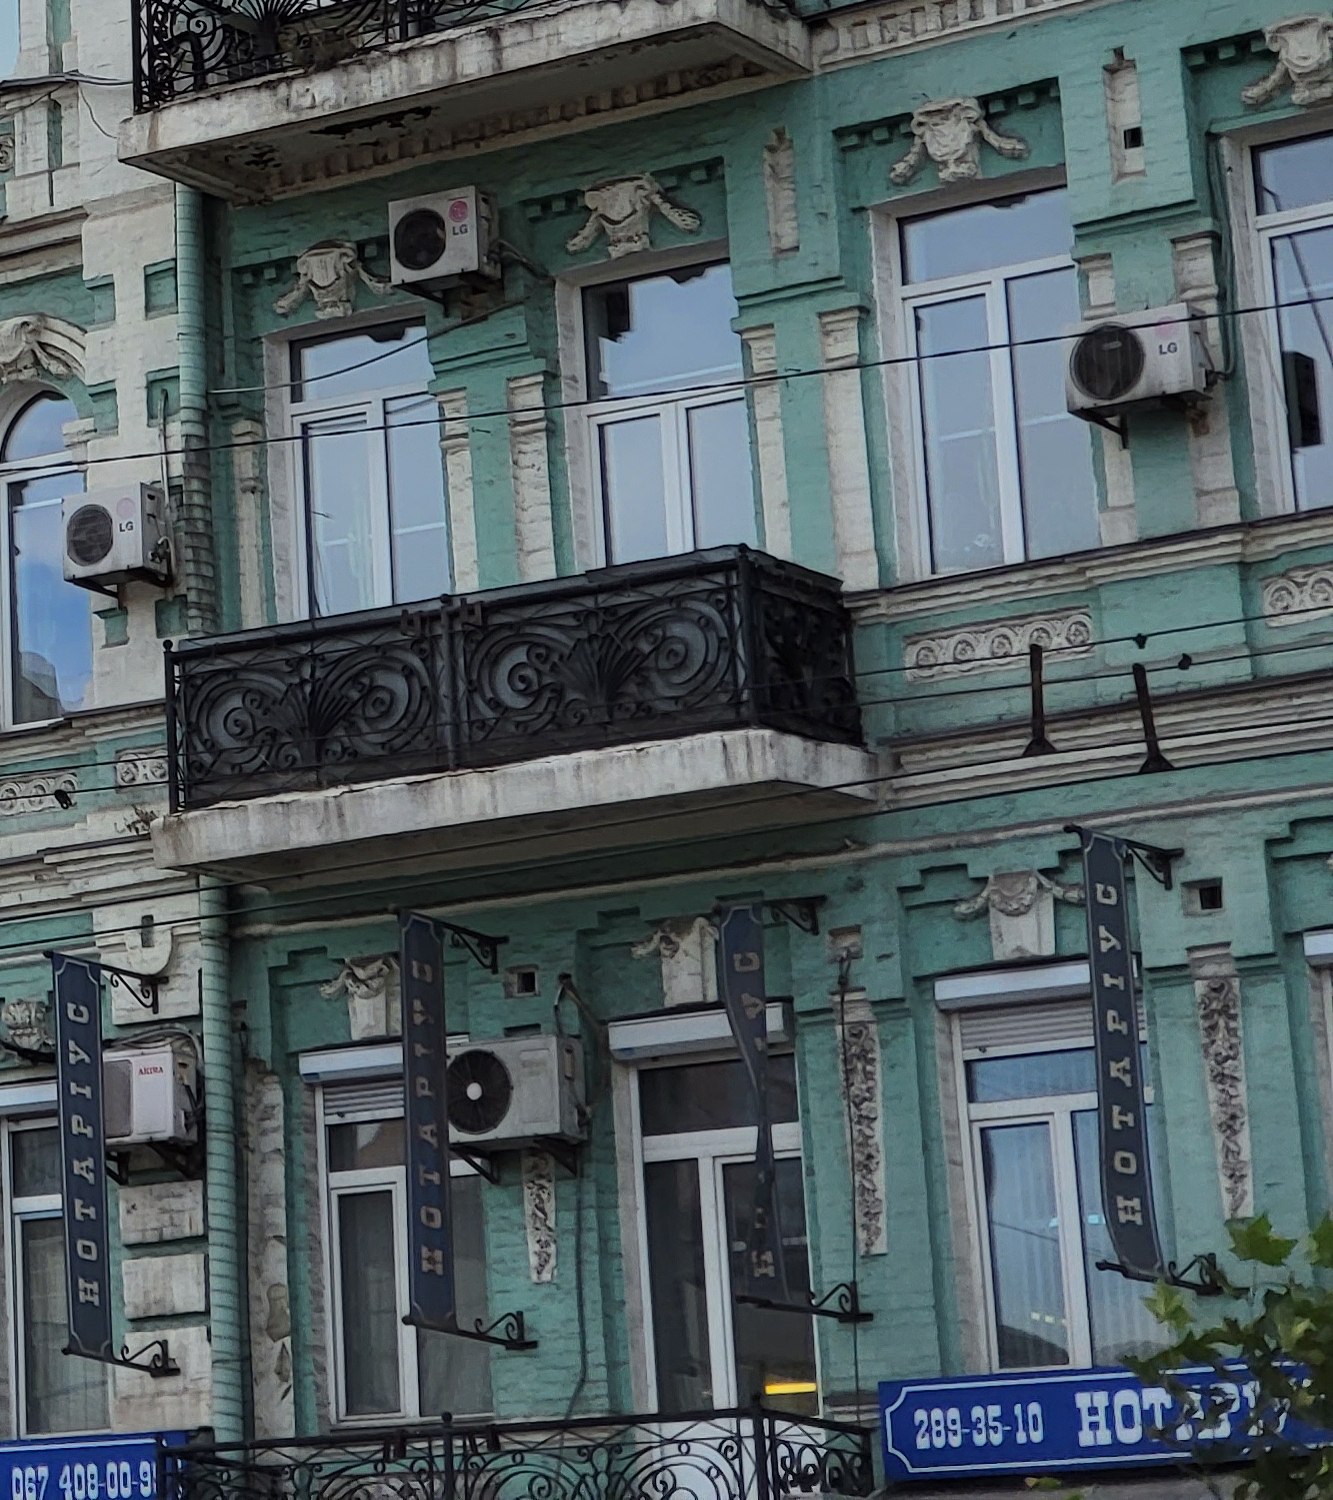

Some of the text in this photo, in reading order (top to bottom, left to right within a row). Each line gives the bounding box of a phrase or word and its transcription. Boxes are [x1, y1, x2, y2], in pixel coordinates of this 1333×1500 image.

[452, 223, 469, 236] LG
[1158, 341, 1178, 355] LG
[118, 520, 134, 533] LG
[1095, 882, 1142, 1226] НОТАРІУС
[66, 1002, 101, 1308] НОТАРІУС
[913, 1401, 1044, 1451] 289-35-10
[58, 1460, 158, 1500] 408-00-9
